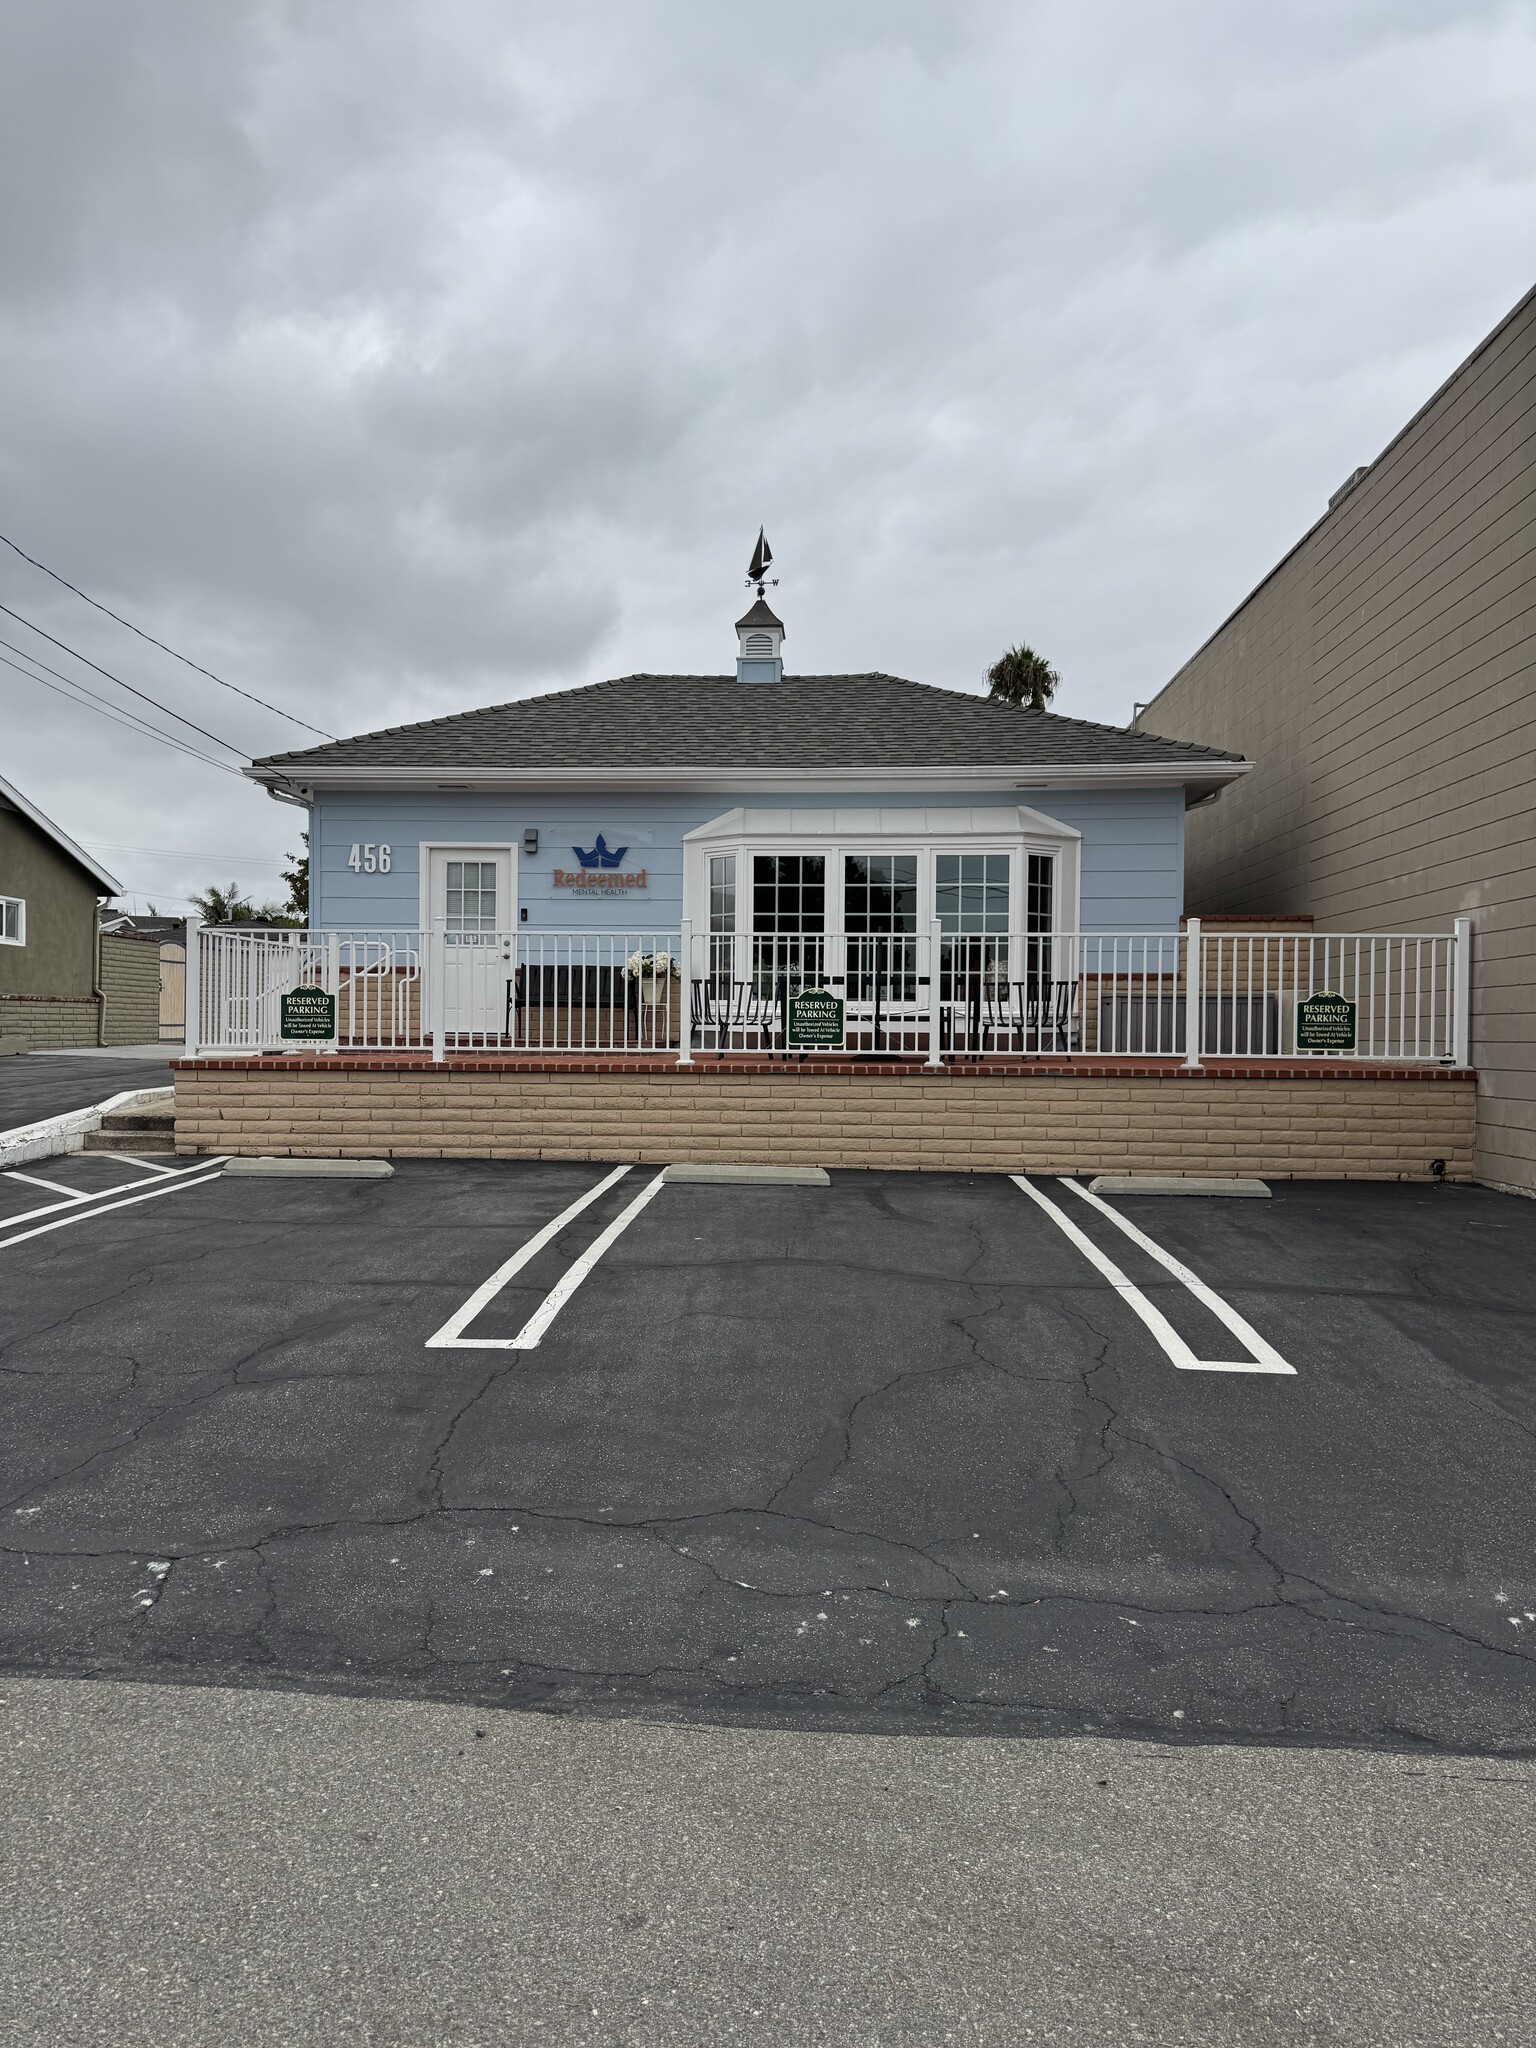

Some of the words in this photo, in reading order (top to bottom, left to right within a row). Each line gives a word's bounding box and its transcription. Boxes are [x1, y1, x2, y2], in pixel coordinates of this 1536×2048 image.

[348, 844, 391, 873] 456
[553, 868, 647, 888] Redeemed
[286, 997, 330, 1005] RESERVED
[794, 1001, 838, 1009] RESERVED
[288, 1006, 328, 1014] PARKING
[1303, 1005, 1350, 1013] RESERVED
[796, 1010, 836, 1018] PARKING
[1305, 1014, 1348, 1023] PARKING
